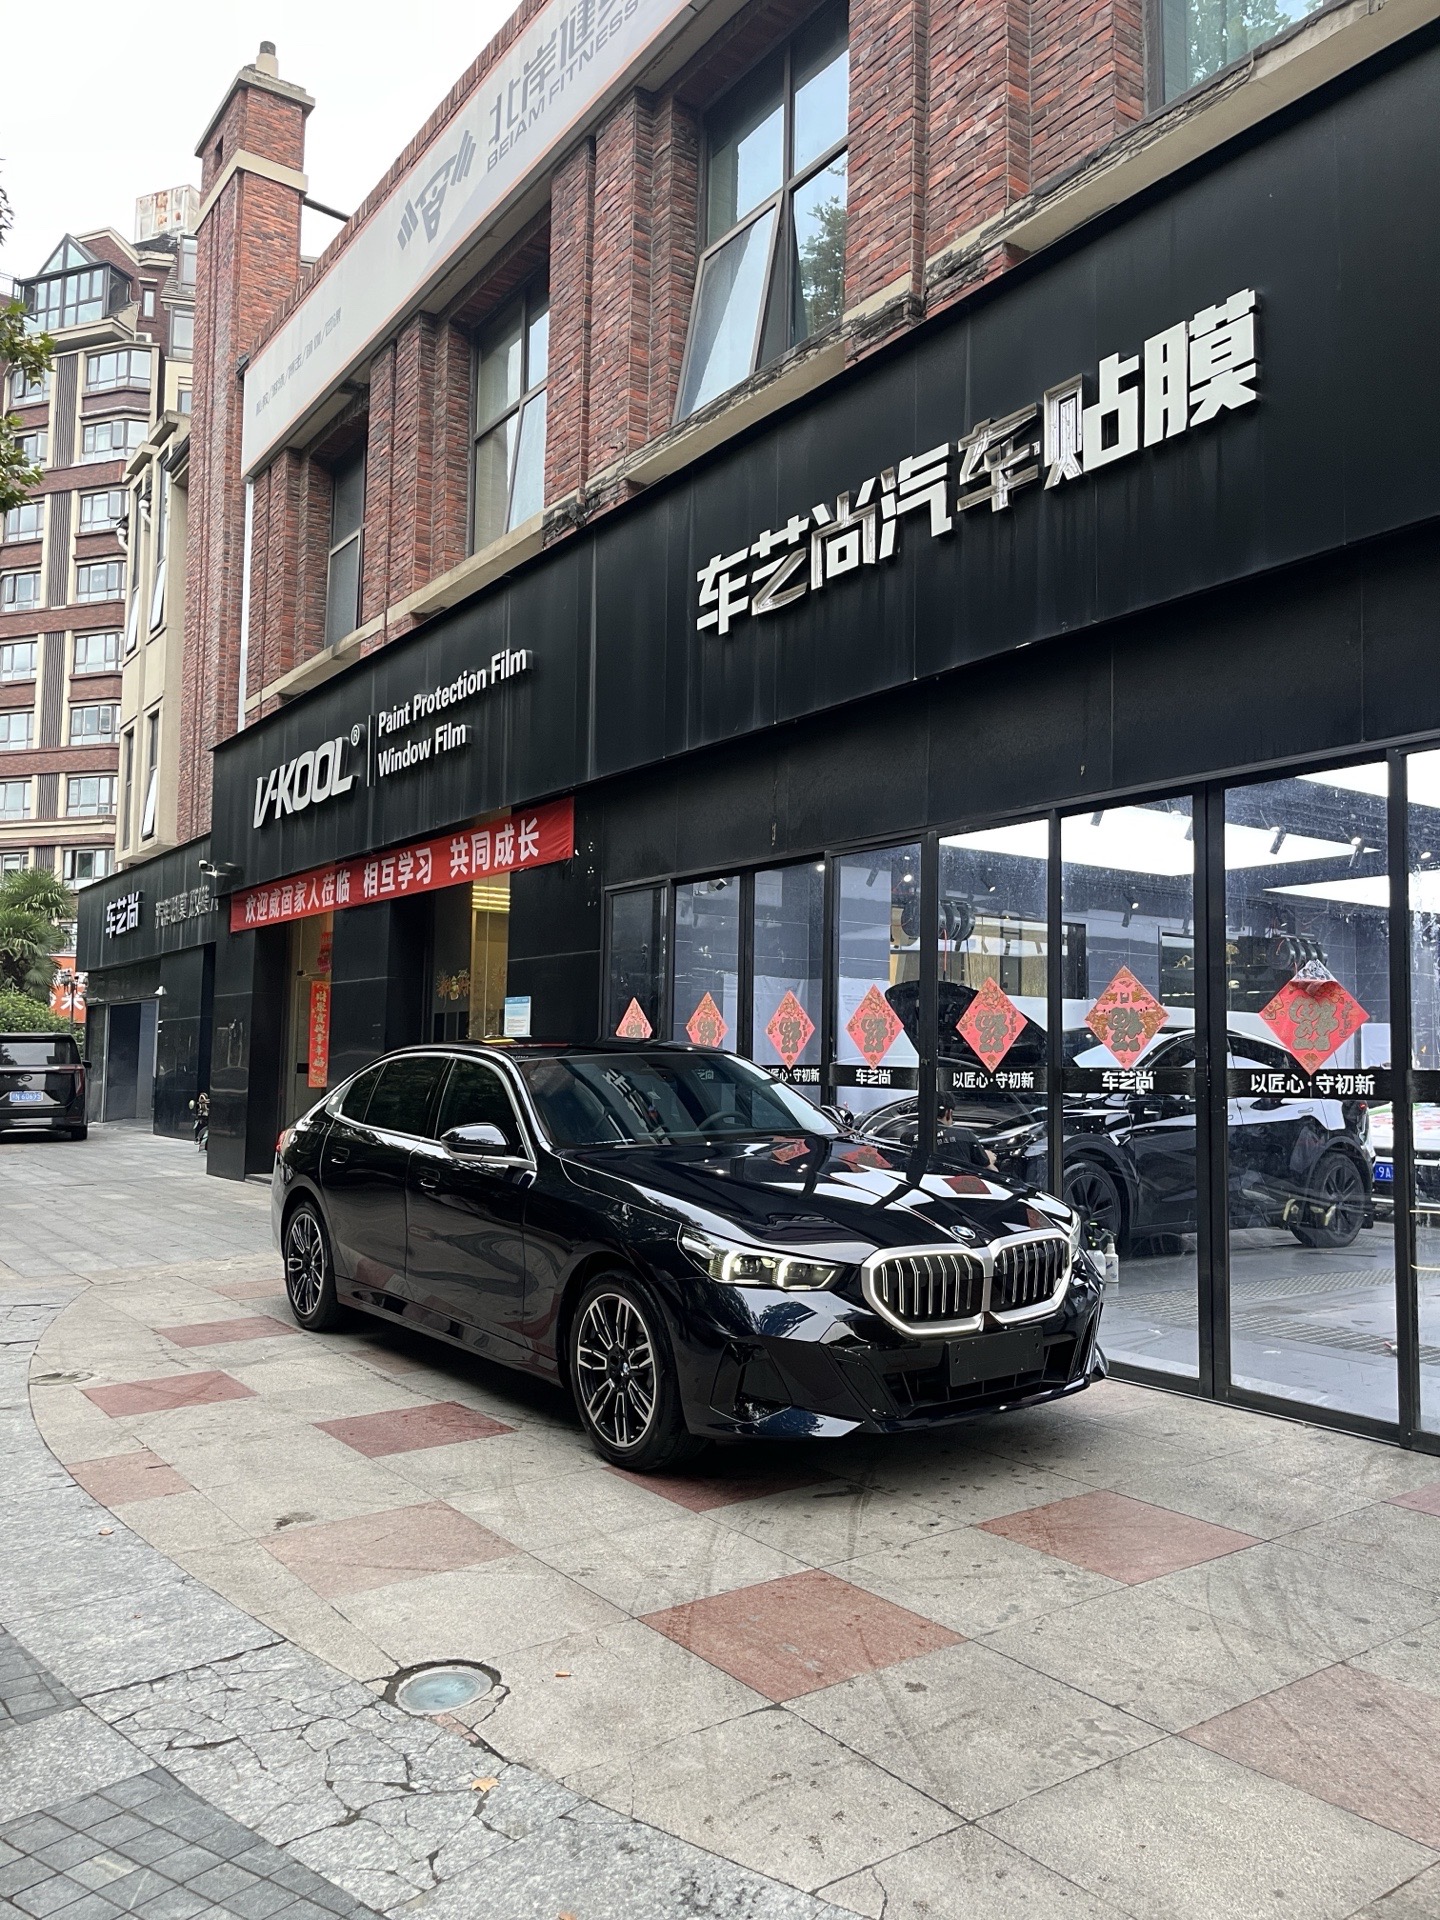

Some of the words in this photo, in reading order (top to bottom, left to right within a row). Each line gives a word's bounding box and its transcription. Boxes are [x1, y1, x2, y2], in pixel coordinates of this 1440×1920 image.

[487, 96, 545, 173] BEIAM
[549, 0, 638, 105] FITNESS
[488, 0, 624, 147] 北岸健
[696, 289, 1258, 635] 车艺尚汽车贴膜
[378, 704, 410, 737] Paint
[413, 669, 487, 720] Protection
[491, 649, 526, 684] Film
[378, 736, 432, 777] Window
[435, 722, 466, 755] Film
[245, 869, 350, 923] 欢迎威固家人莅临
[364, 847, 432, 898] 相互学习
[450, 818, 539, 878] 共同成长
[106, 891, 140, 938] 车艺尚
[767, 1068, 820, 1082] 匠心·守初新
[855, 1068, 892, 1085] 车艺尚
[1101, 1071, 1155, 1091] 车艺尚
